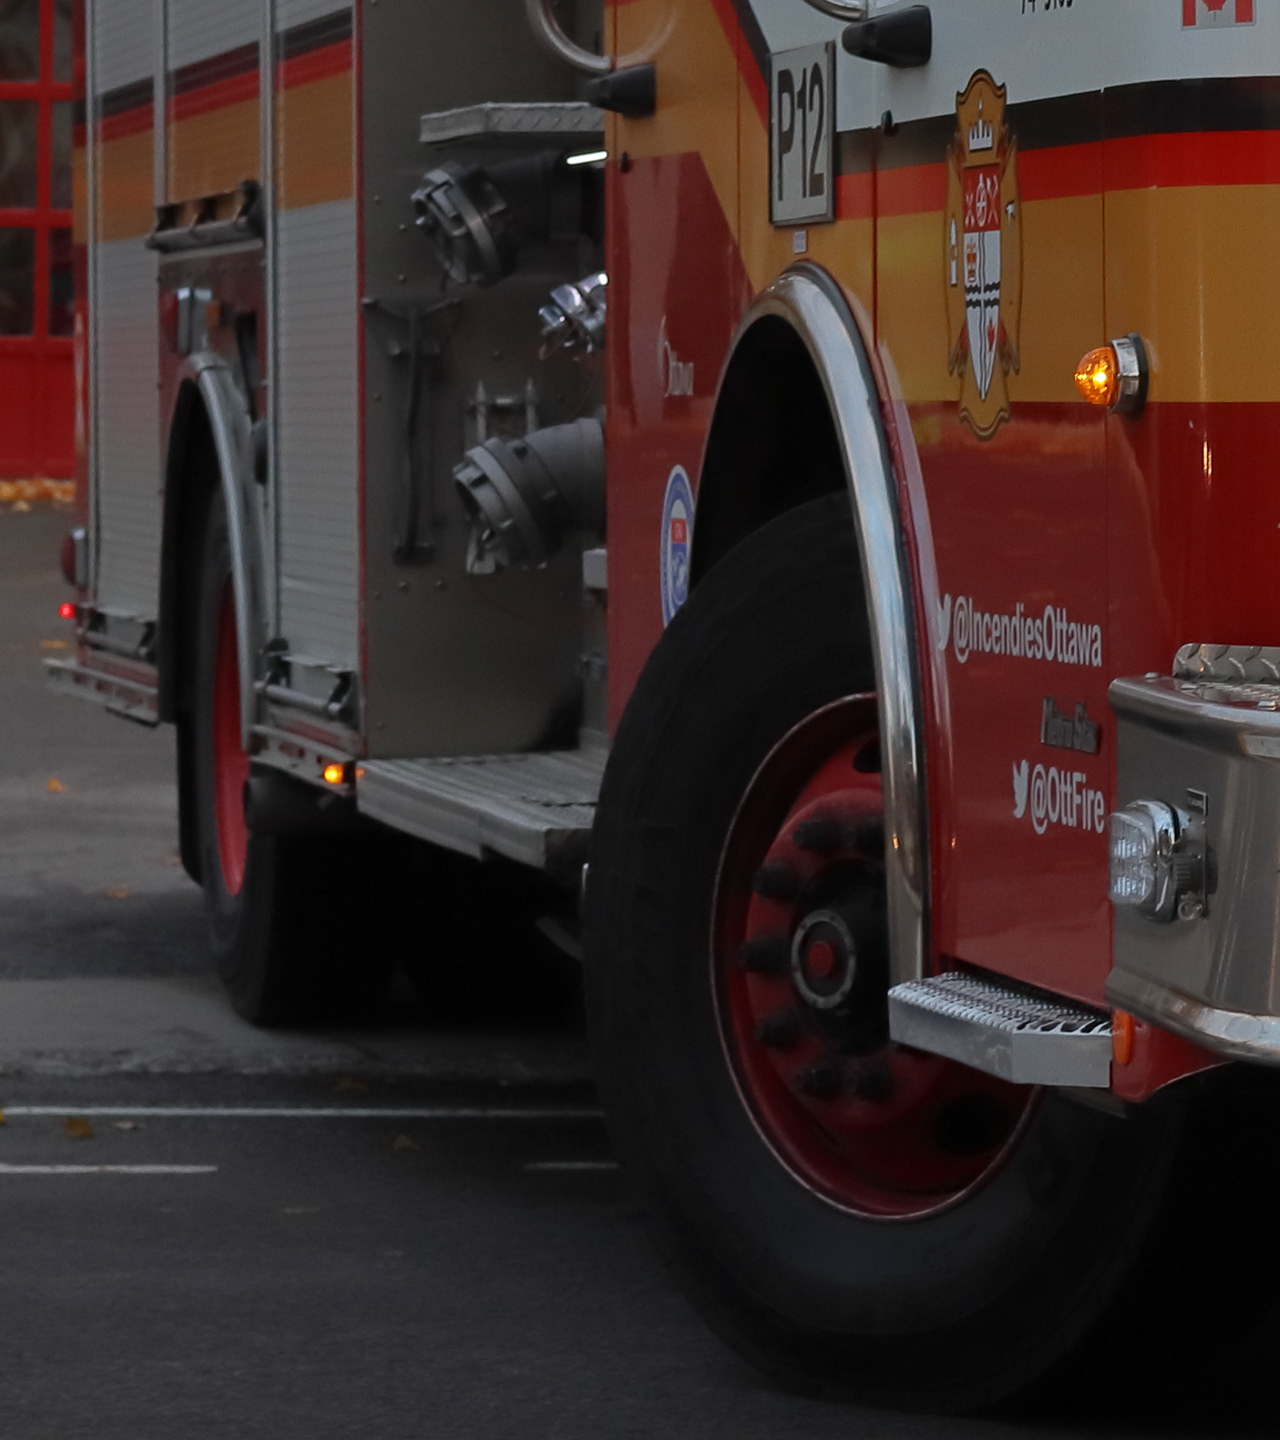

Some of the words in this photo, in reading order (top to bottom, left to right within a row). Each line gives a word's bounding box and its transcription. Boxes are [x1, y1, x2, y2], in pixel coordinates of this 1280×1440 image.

[777, 62, 825, 202] P12
[953, 596, 1102, 667] @IncendiesOttawa
[1030, 763, 1105, 835] @OttFire
